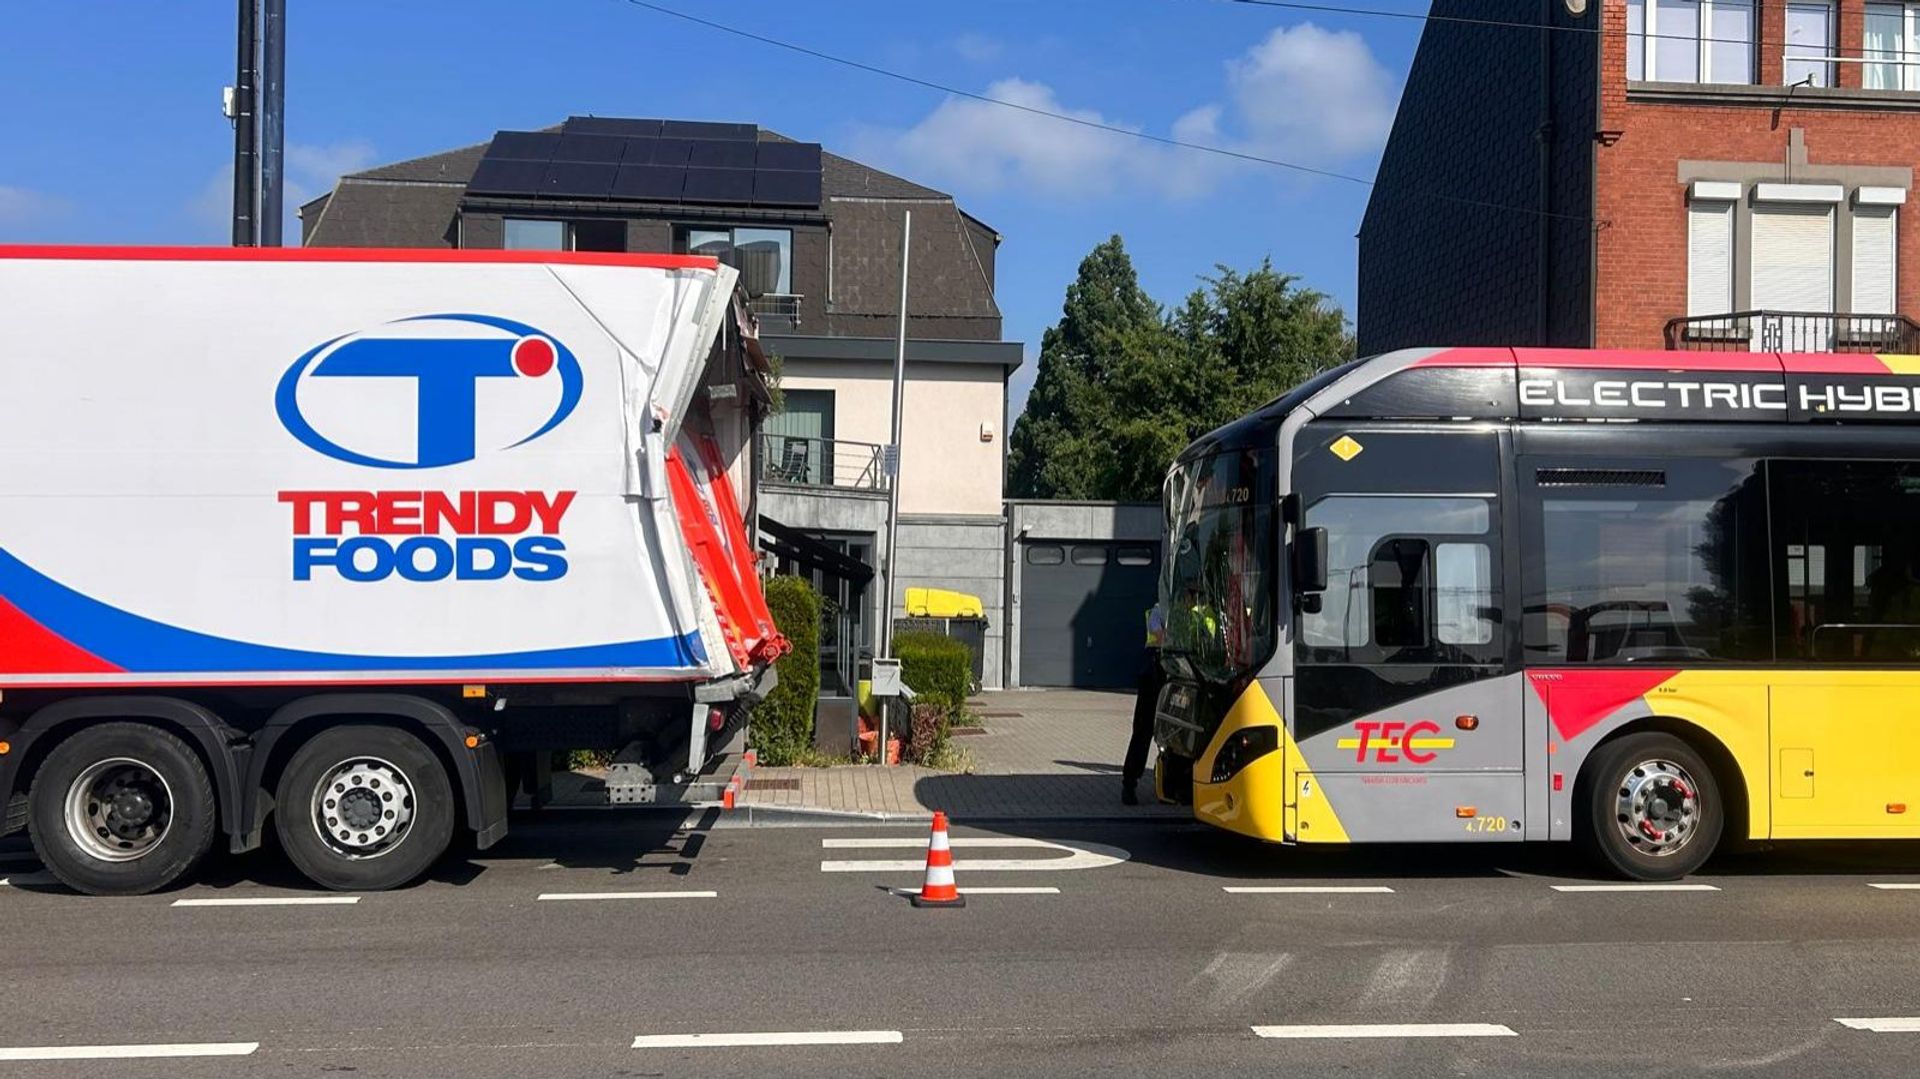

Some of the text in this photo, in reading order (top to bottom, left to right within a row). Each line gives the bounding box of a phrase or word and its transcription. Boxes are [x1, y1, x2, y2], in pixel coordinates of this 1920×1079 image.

[1519, 380, 1920, 412] ELECTRIC HYB
[278, 490, 577, 535] TRENDY
[293, 536, 569, 583] FOODS
[1353, 720, 1441, 764] TEC
[1465, 816, 1506, 833] 4.720
